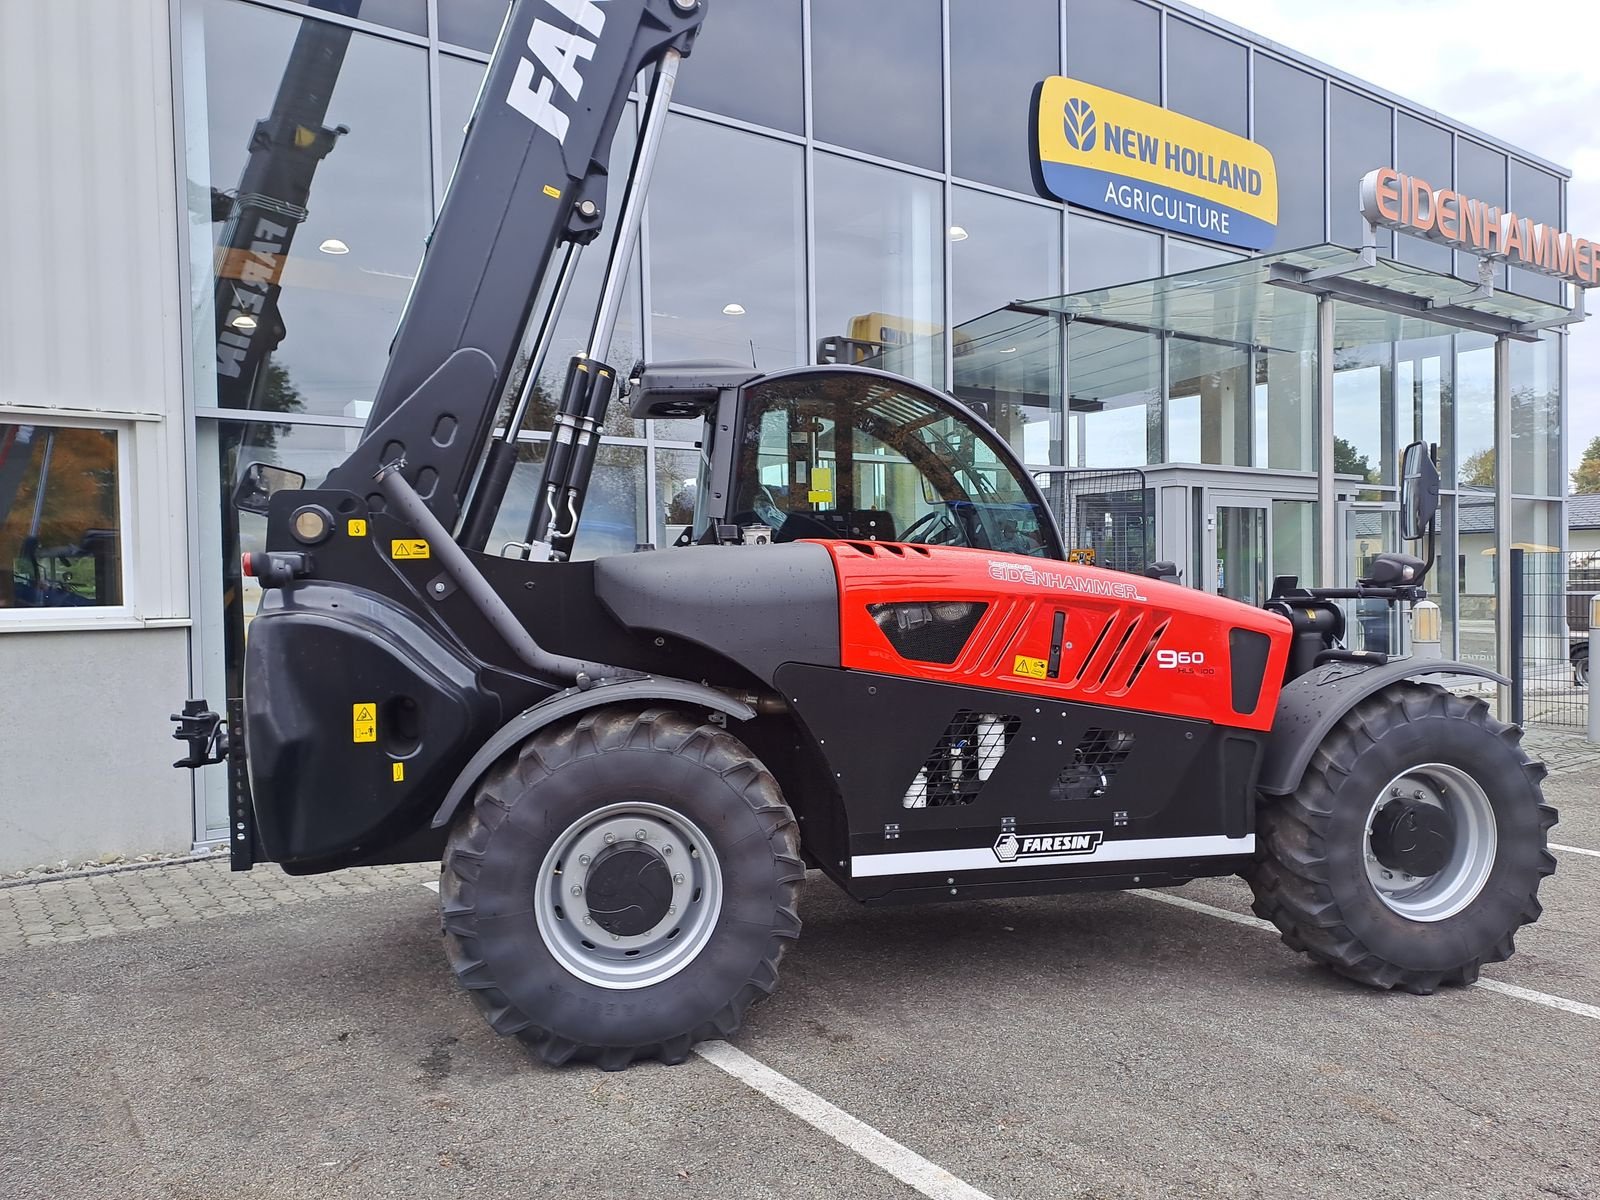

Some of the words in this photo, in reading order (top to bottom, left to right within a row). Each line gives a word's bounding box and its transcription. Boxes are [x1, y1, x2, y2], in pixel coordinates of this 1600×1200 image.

[1104, 122, 1159, 165] NEW
[1165, 141, 1262, 196] HOLLAND
[1104, 181, 1230, 235] AGRICULTURE
[988, 565, 1138, 600] EIDENHAMMER
[1156, 649, 1205, 670] 960
[1459, 653, 1497, 661] ENTRU
[1022, 835, 1091, 853] FARESIN
